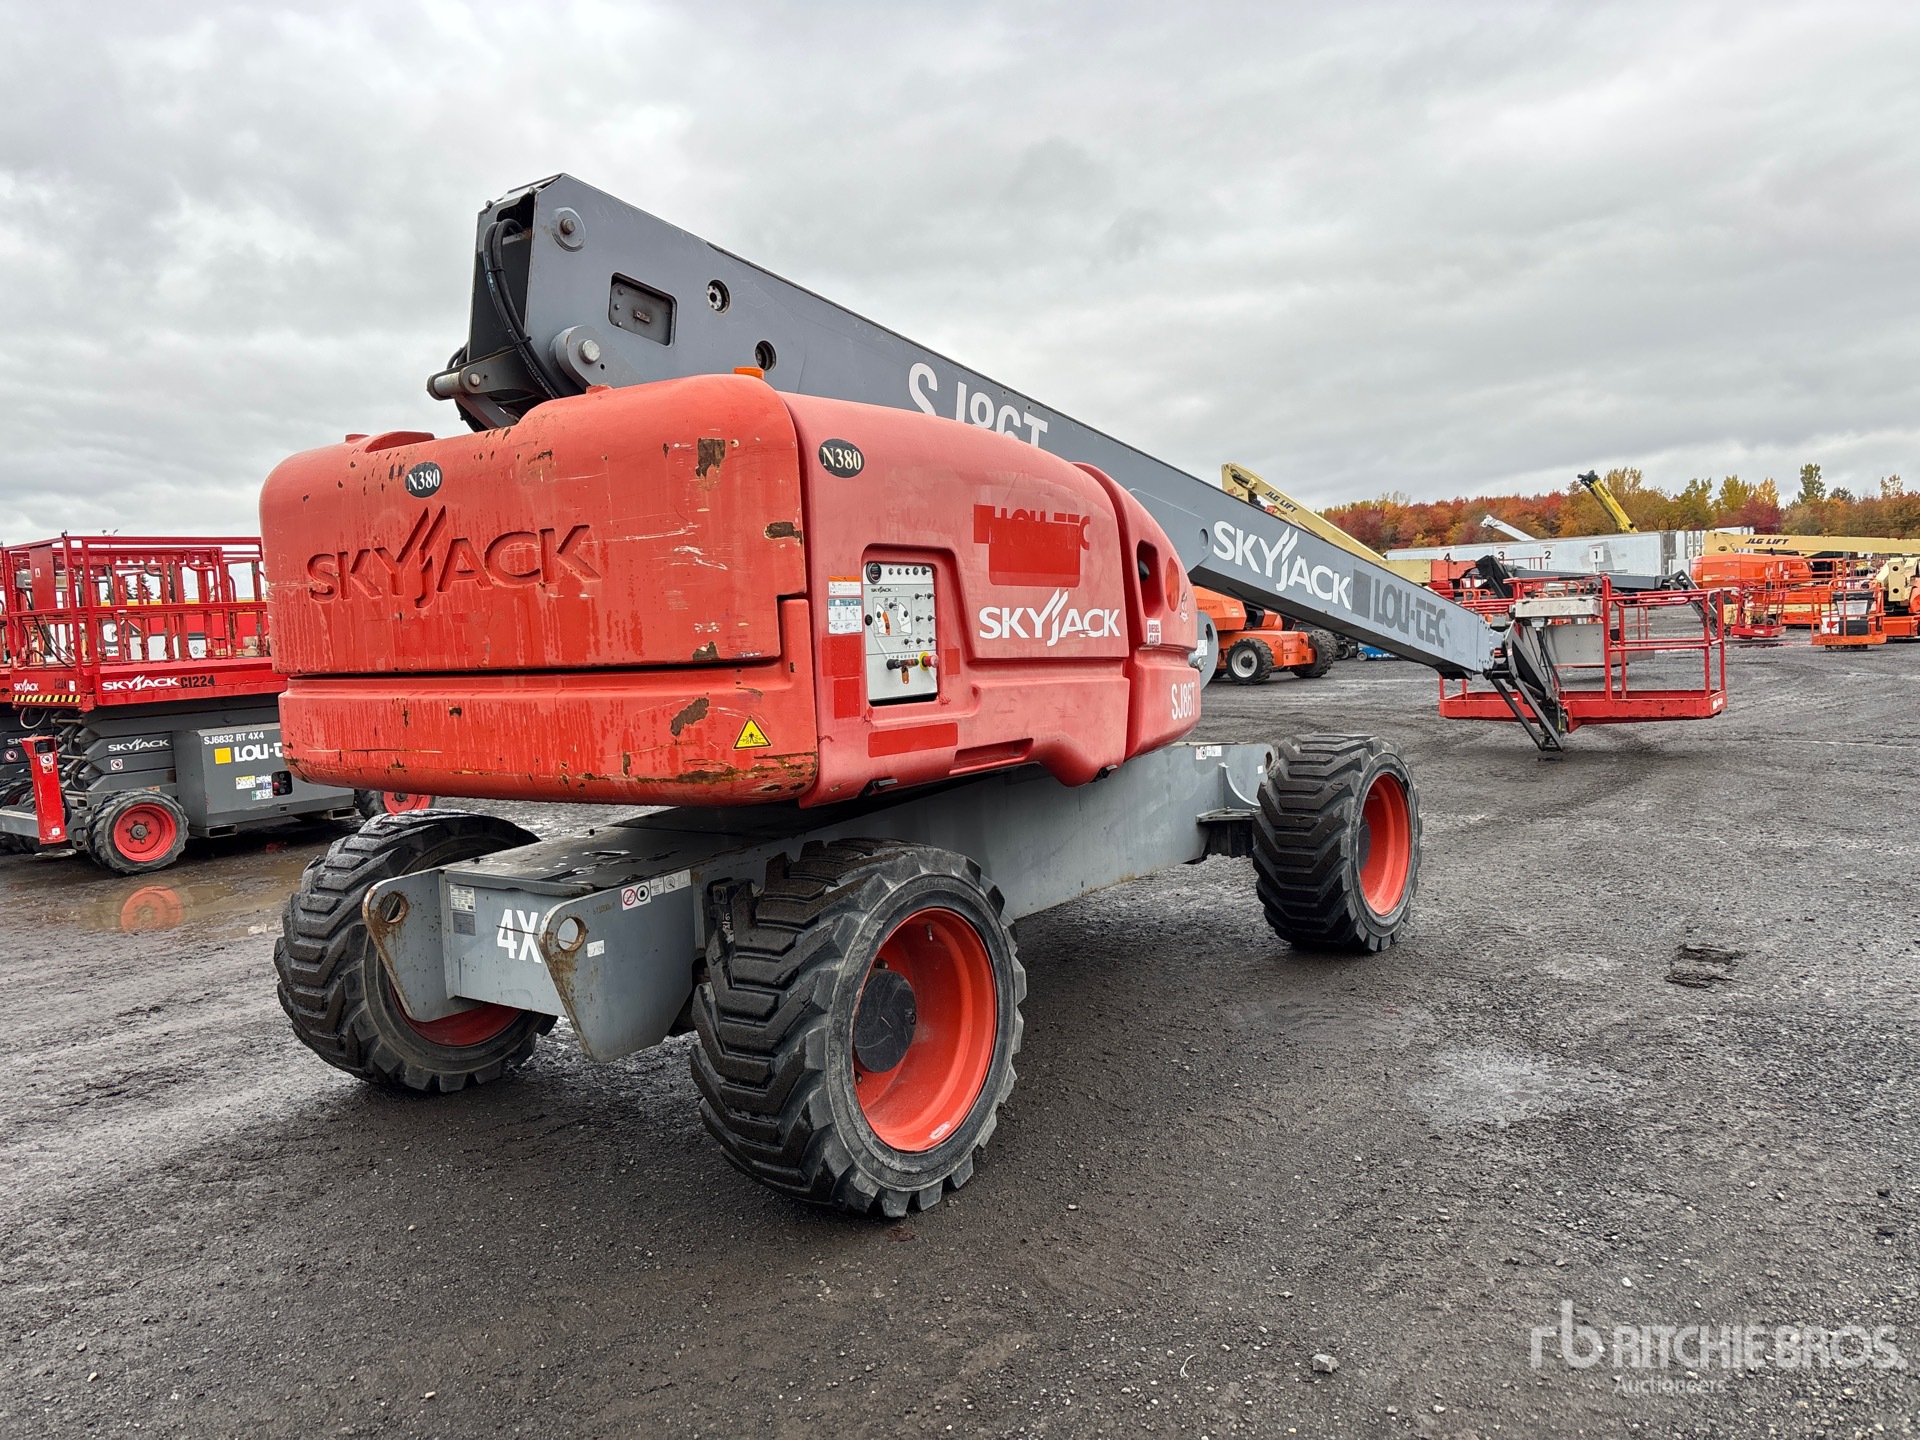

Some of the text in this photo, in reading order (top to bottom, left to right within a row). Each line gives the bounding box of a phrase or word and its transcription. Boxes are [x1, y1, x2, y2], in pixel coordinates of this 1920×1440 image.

[823, 446, 862, 470] N380
[407, 468, 441, 492] N380
[1265, 491, 1298, 513] JLG LIFT
[306, 504, 602, 610] SKYJACK
[1497, 551, 1505, 561] 3
[1544, 550, 1552, 560] 2
[1593, 550, 1599, 559] 1
[1213, 520, 1352, 611] SKYJACK
[978, 587, 1121, 647] SKYJACK
[13, 679, 39, 693] SKYJACK
[102, 675, 180, 692] SKYJACK
[108, 738, 170, 752] SKYJACK
[203, 731, 264, 746] SJ6832 RT 4X4
